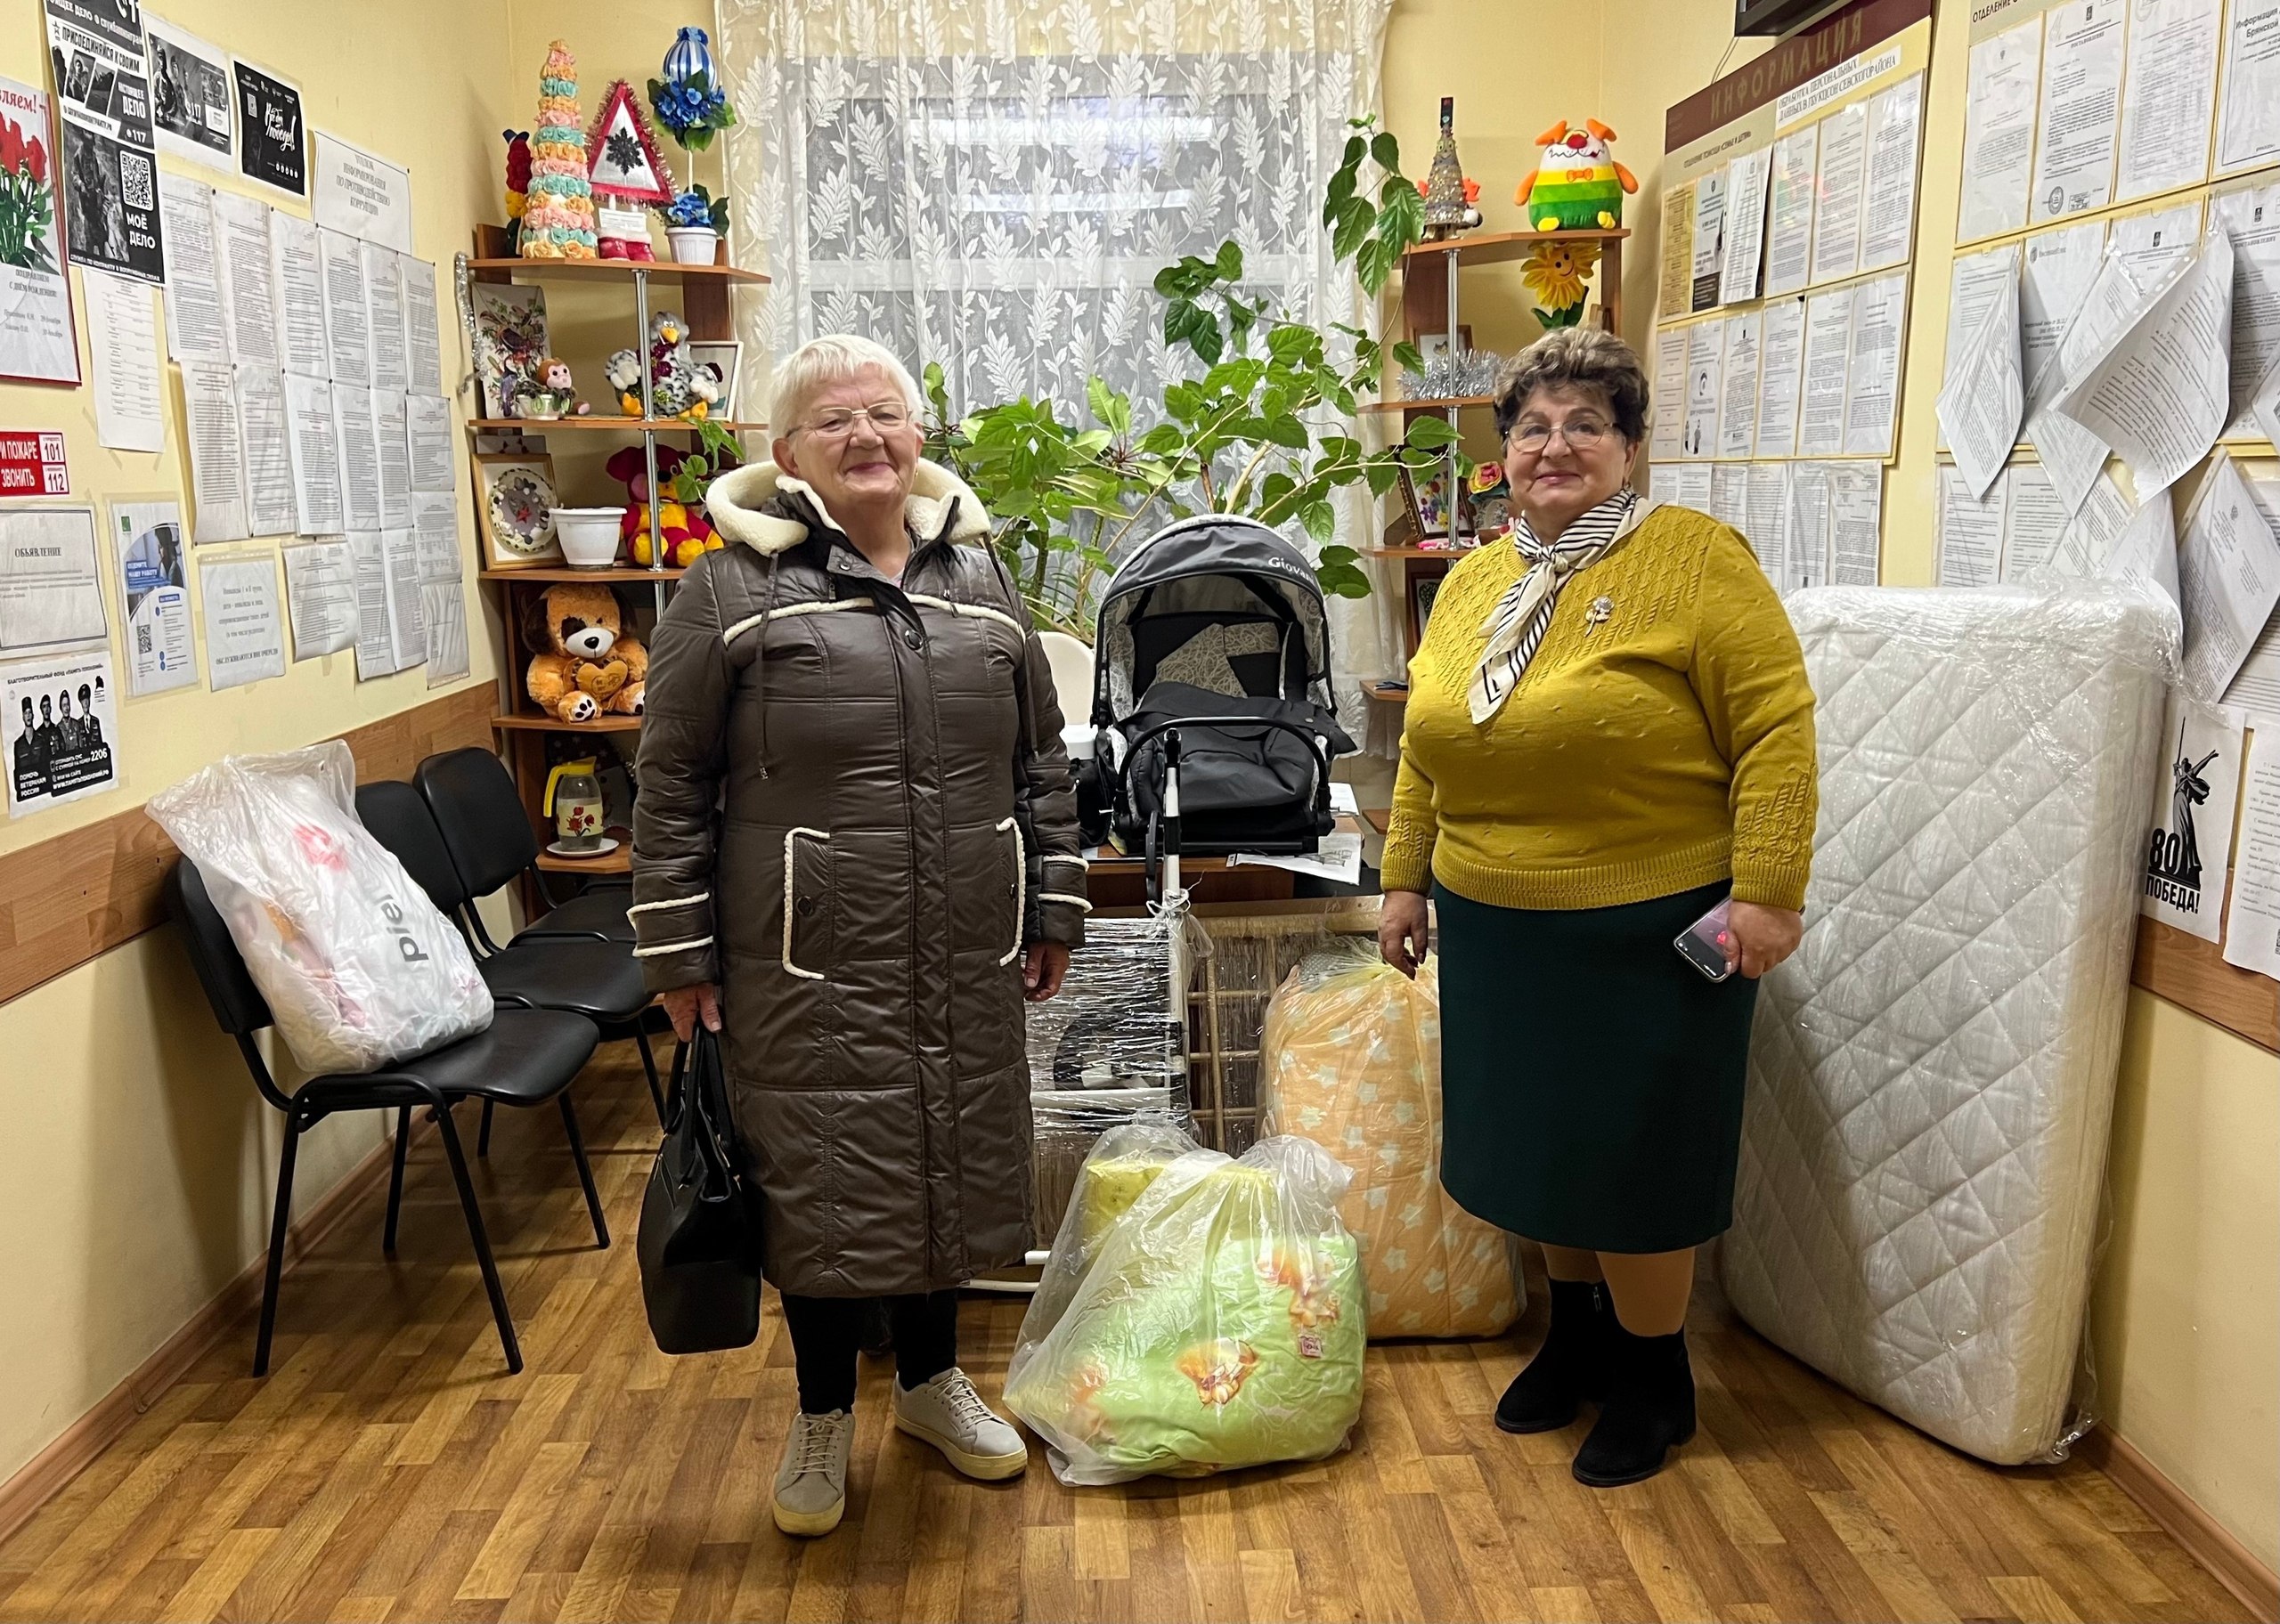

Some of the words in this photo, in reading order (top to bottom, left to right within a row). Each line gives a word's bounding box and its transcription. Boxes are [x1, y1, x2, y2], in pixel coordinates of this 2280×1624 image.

[1972, 0, 2011, 23] ОТДЕЛЕНИЕ
[2235, 7, 2278, 29] Информация
[118, 53, 140, 73] СВОИМ
[1710, 10, 1862, 124] ИНФОРМАЦИЯ
[1810, 58, 1858, 93] ПЕРСОНАЛЬНЫХ
[0, 90, 37, 113] ляем!
[122, 95, 146, 119] ДЕЛО
[132, 129, 147, 143] 117
[126, 212, 148, 231] МОЁ
[129, 231, 156, 249] ДЕЛО
[6, 441, 38, 459] ПОЖАРЕ
[44, 443, 61, 461] 101
[0, 468, 36, 488] ЗВОНИТЬ
[48, 473, 64, 491] 112
[90, 748, 108, 762] 2206
[2149, 827, 2180, 873] 80
[2146, 874, 2200, 914] ПОБЕДА!
